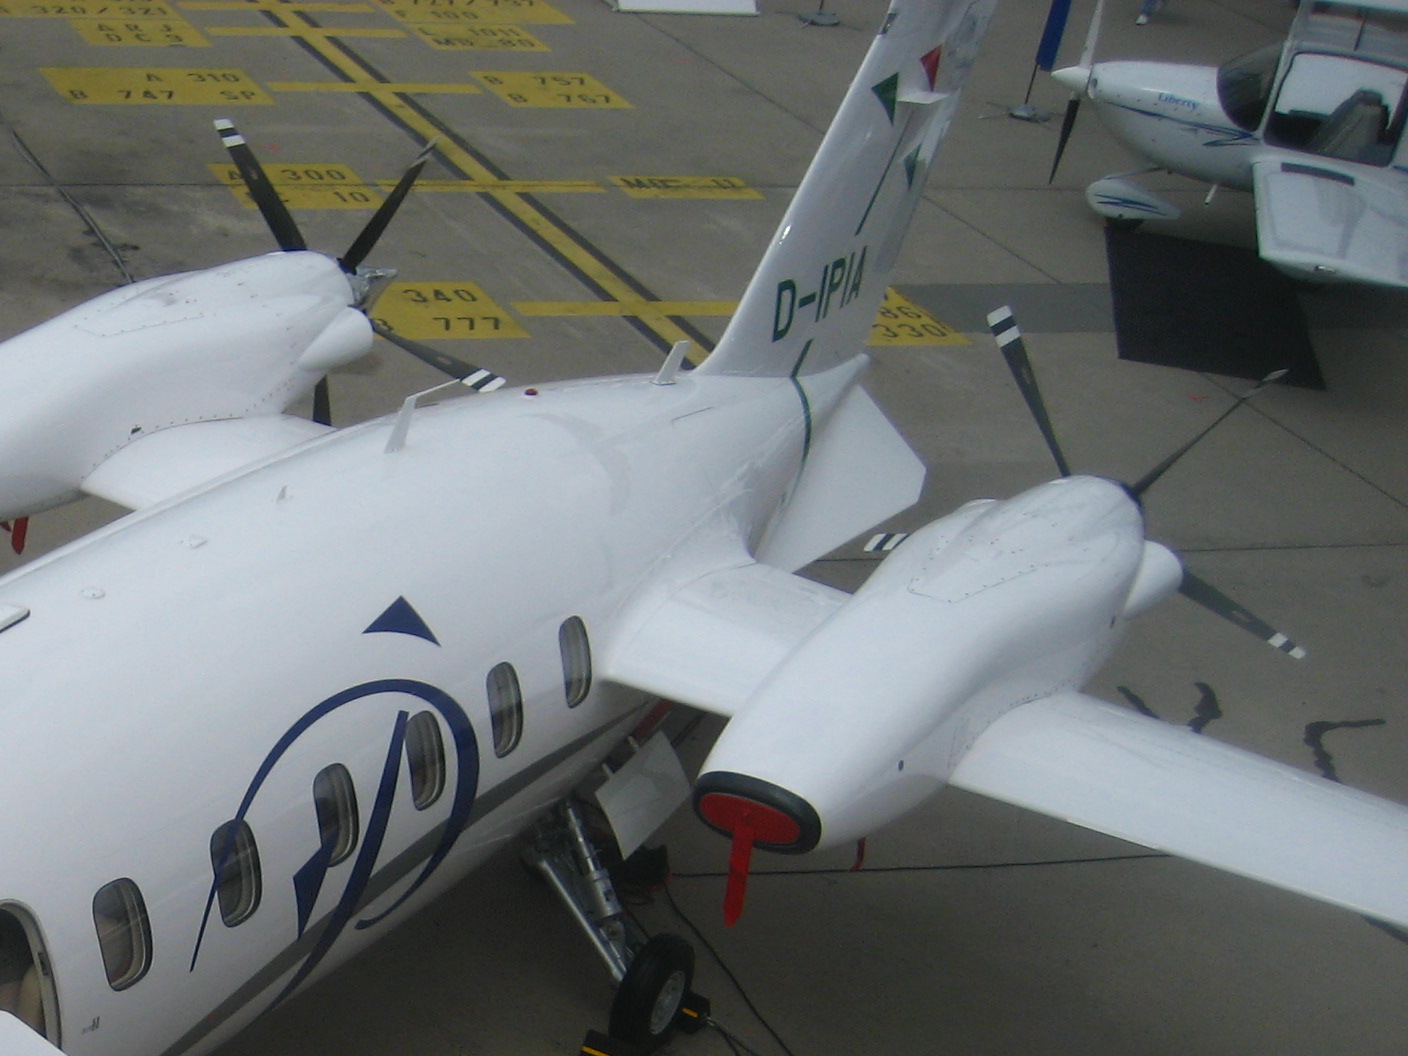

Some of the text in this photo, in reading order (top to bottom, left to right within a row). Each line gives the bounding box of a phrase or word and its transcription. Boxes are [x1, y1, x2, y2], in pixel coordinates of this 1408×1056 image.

[146, 73, 241, 84] A 310
[484, 75, 586, 86] B 757
[68, 89, 256, 101] B 747 SP
[507, 92, 611, 104] B 767
[1158, 92, 1199, 110] Liberty
[280, 169, 347, 181] 300
[333, 191, 371, 204] 10
[403, 288, 479, 303] 340
[772, 246, 867, 342] D-IPIA
[432, 316, 501, 331] 777
[871, 323, 947, 338] 330
